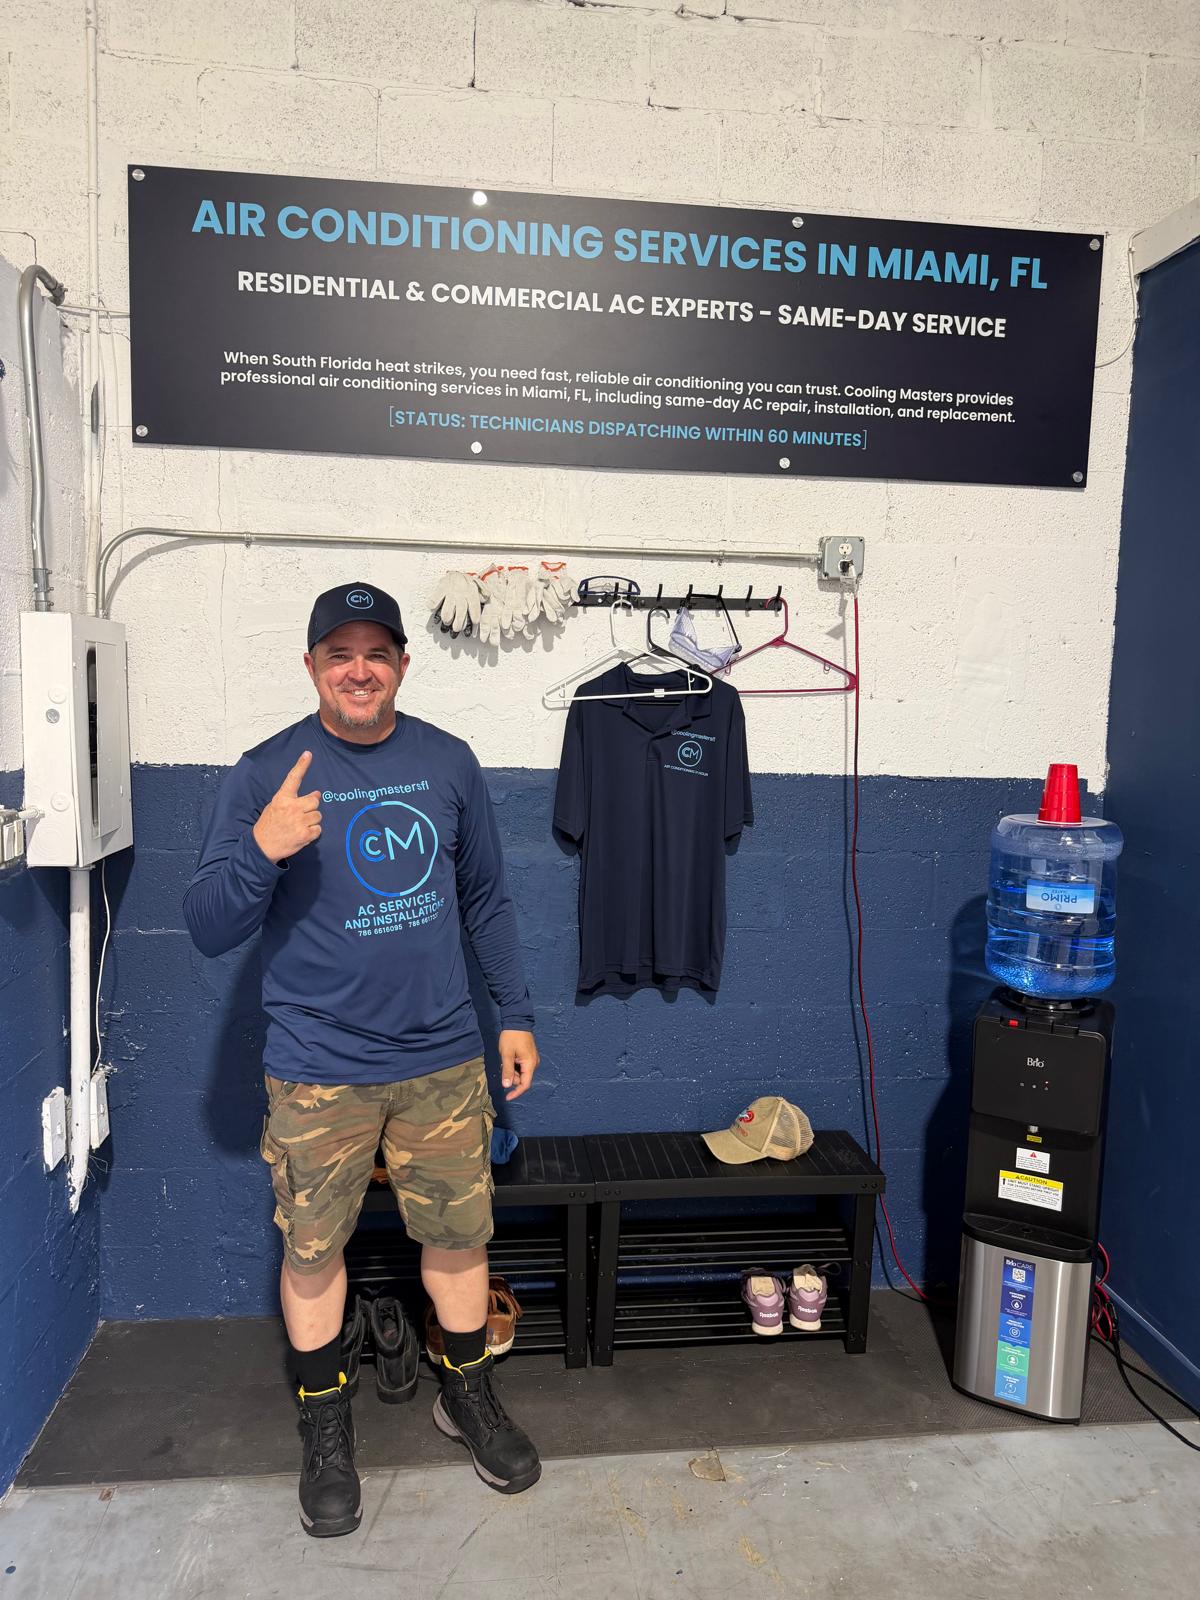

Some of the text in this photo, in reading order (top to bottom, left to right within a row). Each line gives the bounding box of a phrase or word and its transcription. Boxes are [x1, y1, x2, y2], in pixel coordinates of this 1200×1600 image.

[191, 199, 1048, 292] AIR CONDITIONING SERVICES IN MIAMI, FL
[238, 270, 400, 301] RESIDENTIAL
[405, 281, 426, 302] &
[431, 282, 604, 313] COMMERCIAL
[608, 293, 645, 315] AC
[651, 296, 754, 323] EXPERTS
[777, 304, 908, 332] SAME-DAY
[911, 312, 1007, 338] SERVICE
[223, 350, 1014, 407] When South Florida heat strikes, you need fast, reliable air conditioning you can trust. Cooling Masters provides
[220, 370, 1016, 423] professional air conditioning services in Miami, FL, including same-day AC repair, installation, and replacement.
[389, 405, 868, 450] [STATUS: TECHNICIANS DISPATCHING WITHIN 60 MINUTES]
[322, 780, 430, 803] @coolingmastersfl
[357, 890, 437, 917] AC SERVICES
[1040, 892, 1078, 904] PRIMO
[344, 897, 446, 930] AND INSTALLATIONS
[358, 928, 372, 937] 786
[1026, 1057, 1045, 1068] Brio
[1019, 1175, 1048, 1185] CAUTION
